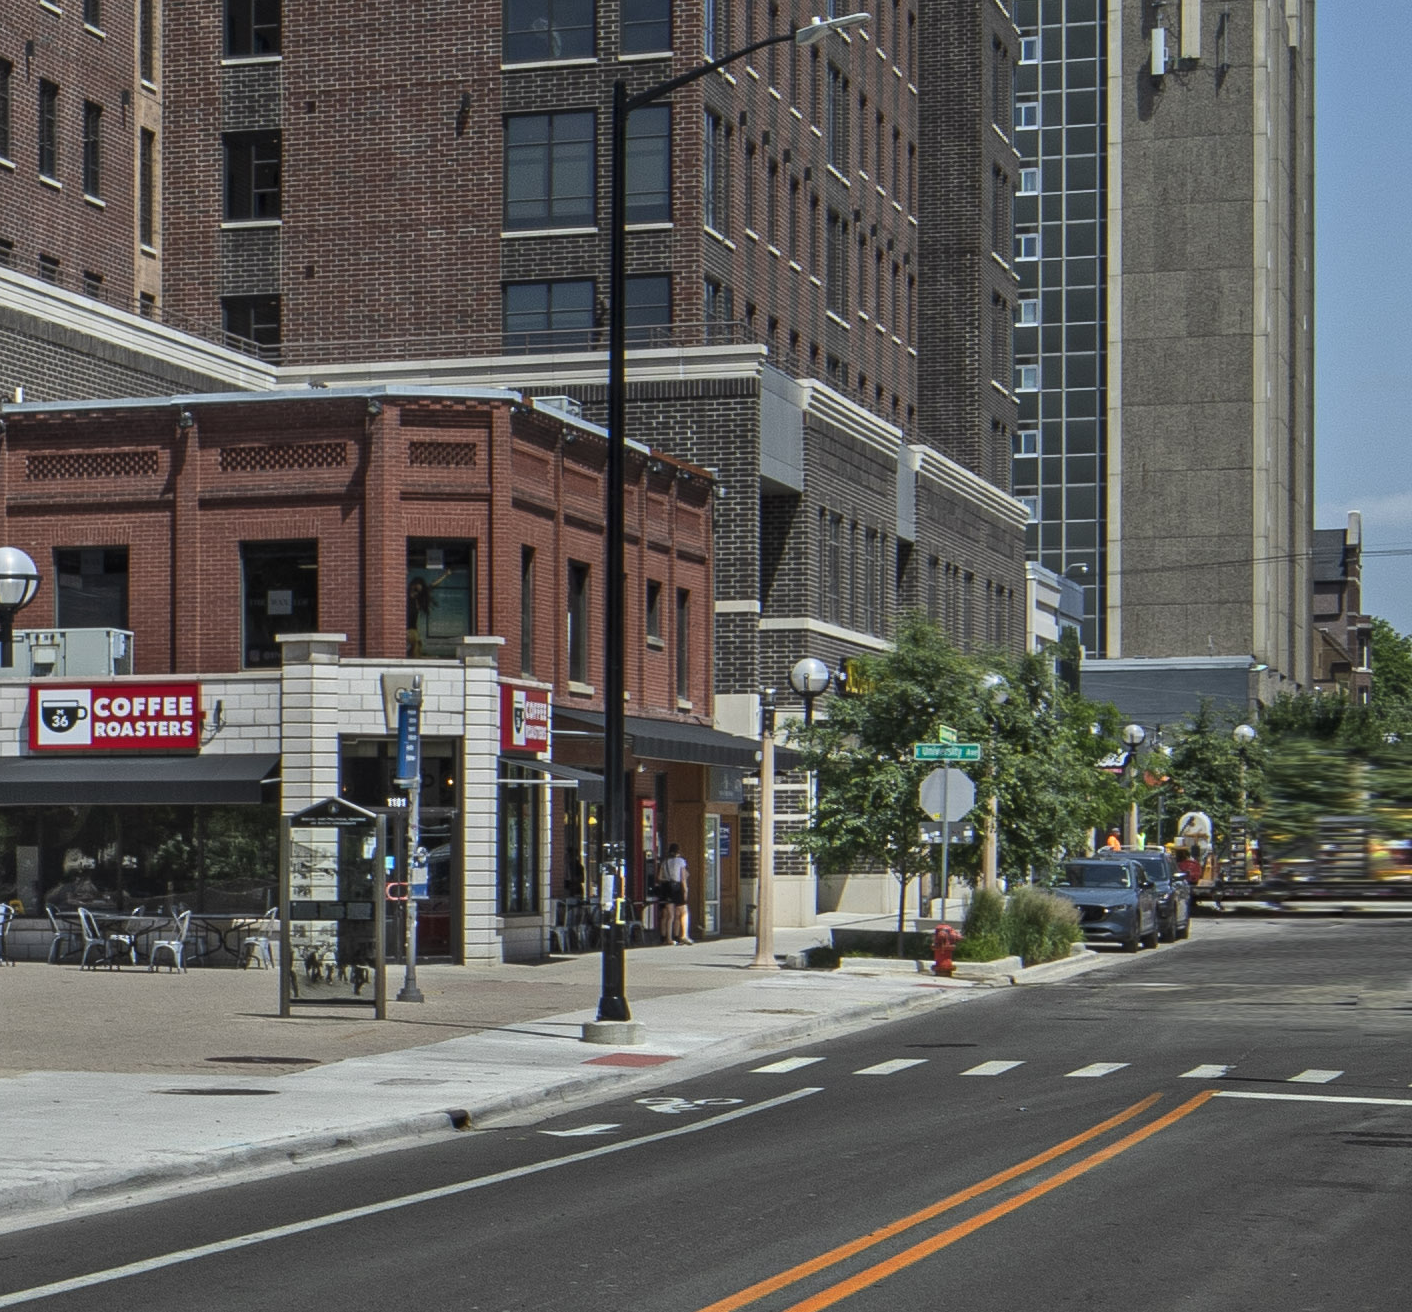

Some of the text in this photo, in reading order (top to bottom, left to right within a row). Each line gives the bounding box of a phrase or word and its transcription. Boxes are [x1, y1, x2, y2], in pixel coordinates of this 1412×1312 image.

[93, 697, 193, 717] COFFEE
[51, 716, 69, 727] 36
[93, 720, 193, 737] ROASTERS
